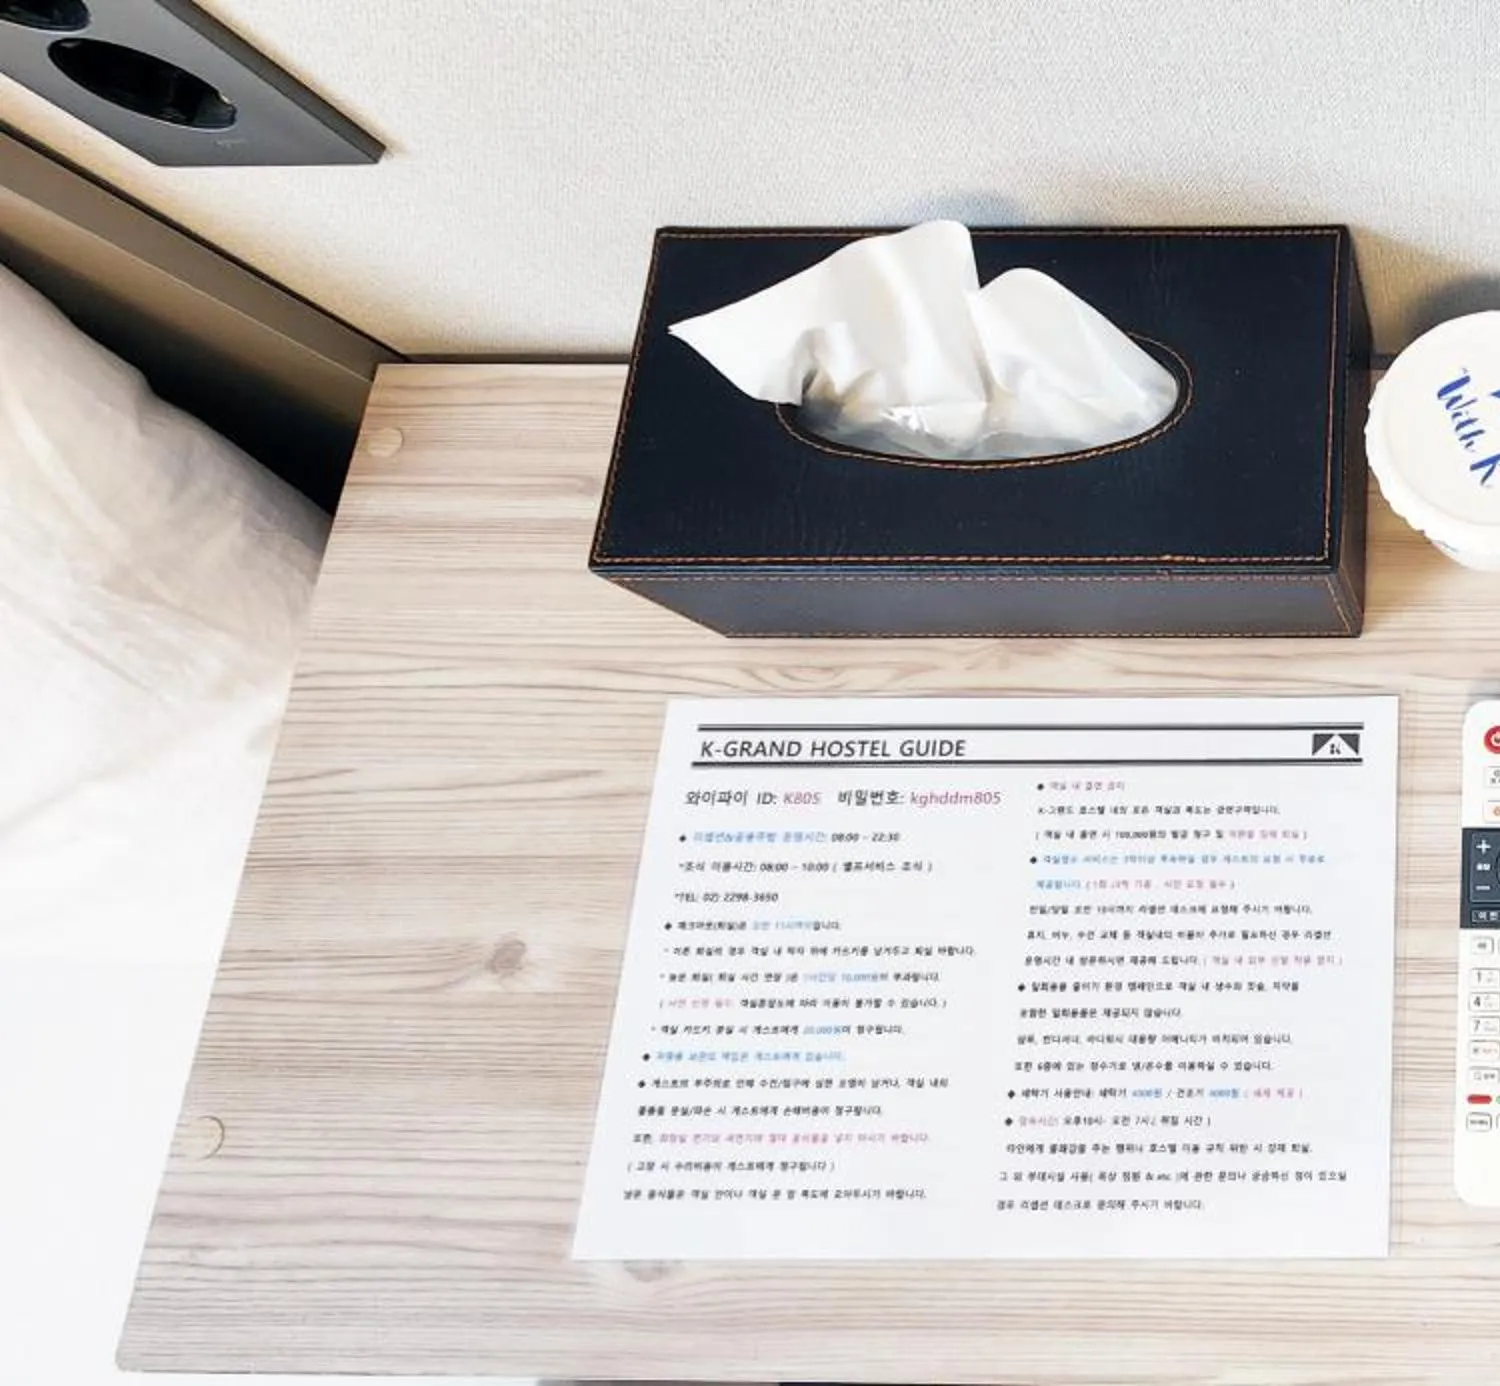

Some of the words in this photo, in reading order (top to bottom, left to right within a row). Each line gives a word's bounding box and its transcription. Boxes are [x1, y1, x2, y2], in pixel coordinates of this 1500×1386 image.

[701, 740, 802, 757] K-GRAND
[810, 740, 891, 757] HOSTEL
[899, 739, 966, 757] GUIDE
[686, 790, 748, 806] 와이파이
[757, 792, 777, 805] ID:
[783, 792, 822, 805] K805
[838, 789, 903, 806] 비밀번호:
[910, 789, 1001, 807] kghddm805
